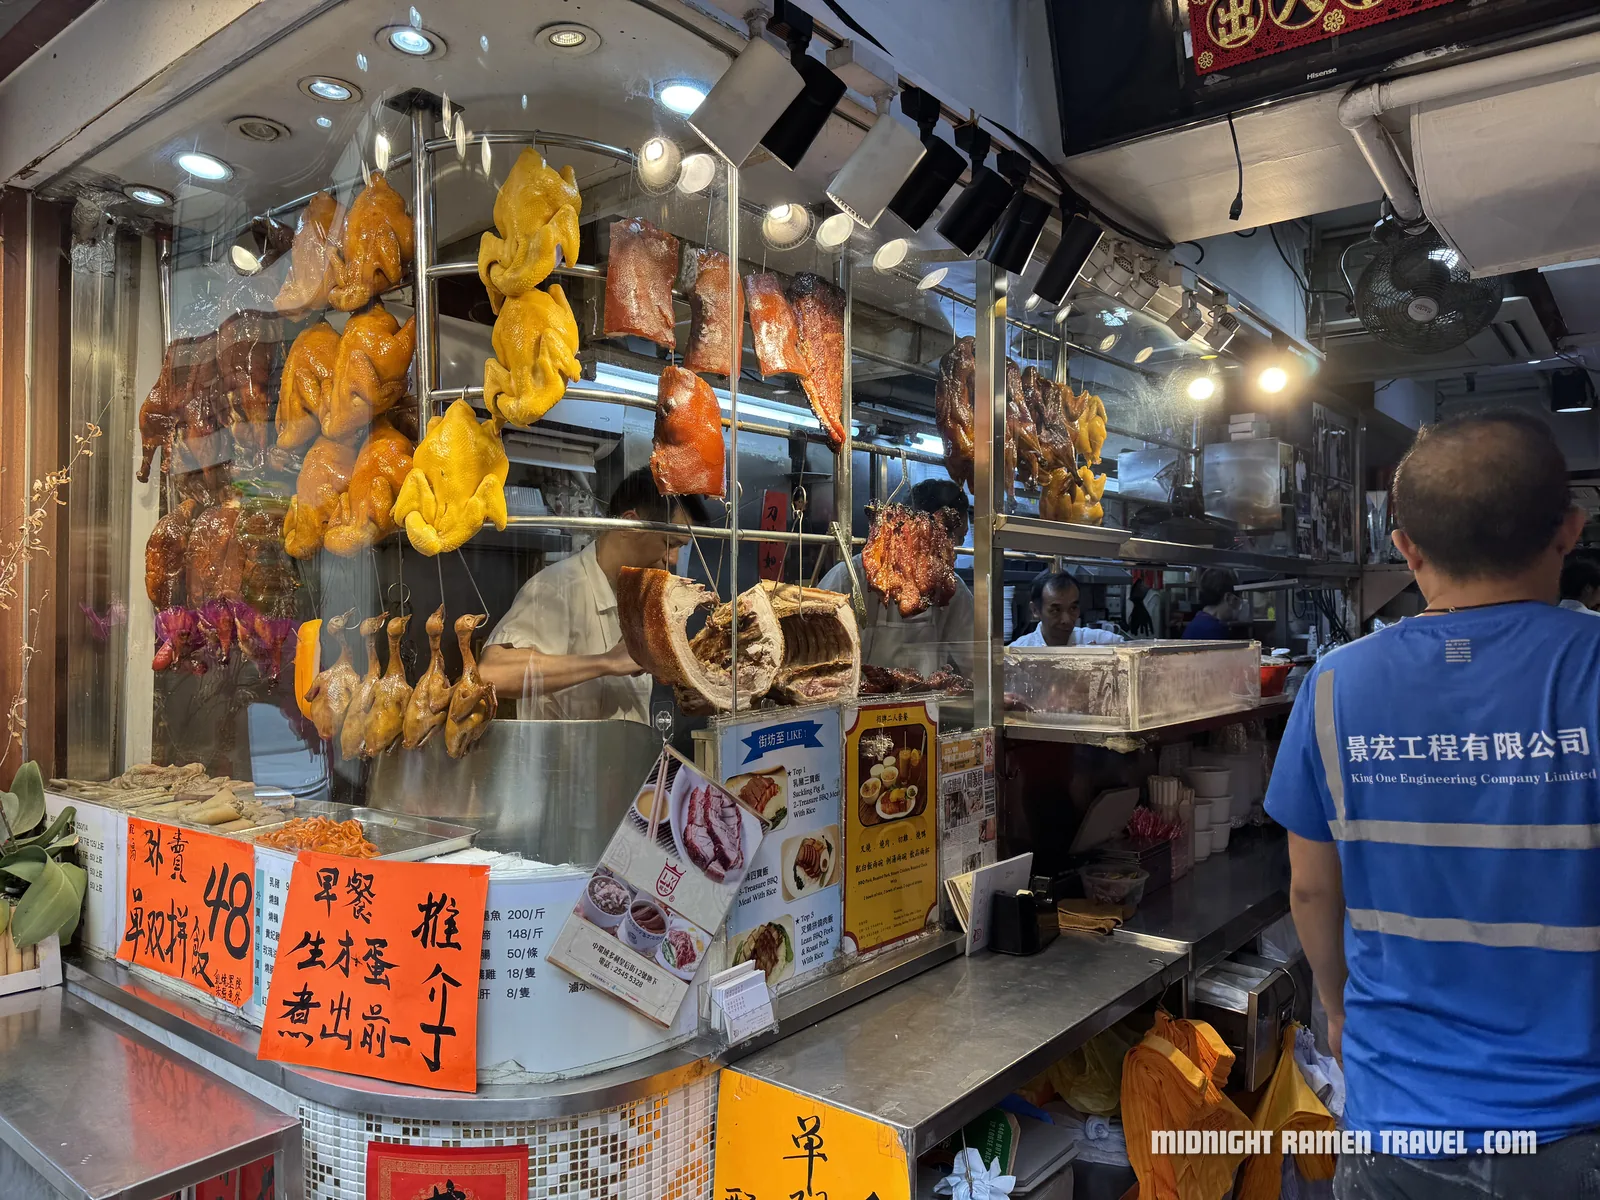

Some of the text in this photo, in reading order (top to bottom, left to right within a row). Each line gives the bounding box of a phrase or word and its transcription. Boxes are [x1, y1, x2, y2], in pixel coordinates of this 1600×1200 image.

[1306, 67, 1338, 80] Hisense
[759, 731, 785, 748] 街坊至
[787, 729, 803, 742] LIKE
[1346, 727, 1590, 763] 景宏工程有限公司
[792, 768, 802, 776] Top
[1351, 768, 1597, 786] King One Engineering Company Limited
[793, 796, 818, 808] 2-Treasure
[819, 793, 829, 802] BBQ
[793, 806, 816, 818] With Rice
[144, 826, 189, 883] 外賣
[766, 875, 778, 886] BBQ
[314, 867, 376, 924] 早餐
[738, 888, 777, 907] Meat With Rice
[203, 862, 252, 960] 48
[507, 908, 546, 920] 200/斤
[801, 914, 811, 922] Top
[507, 927, 544, 940] 148/斤
[812, 930, 823, 940] BBQ
[507, 947, 538, 960] 50/條
[802, 951, 824, 966] With Rice
[506, 967, 536, 980] 18/隻
[506, 987, 530, 1000] 8/隻
